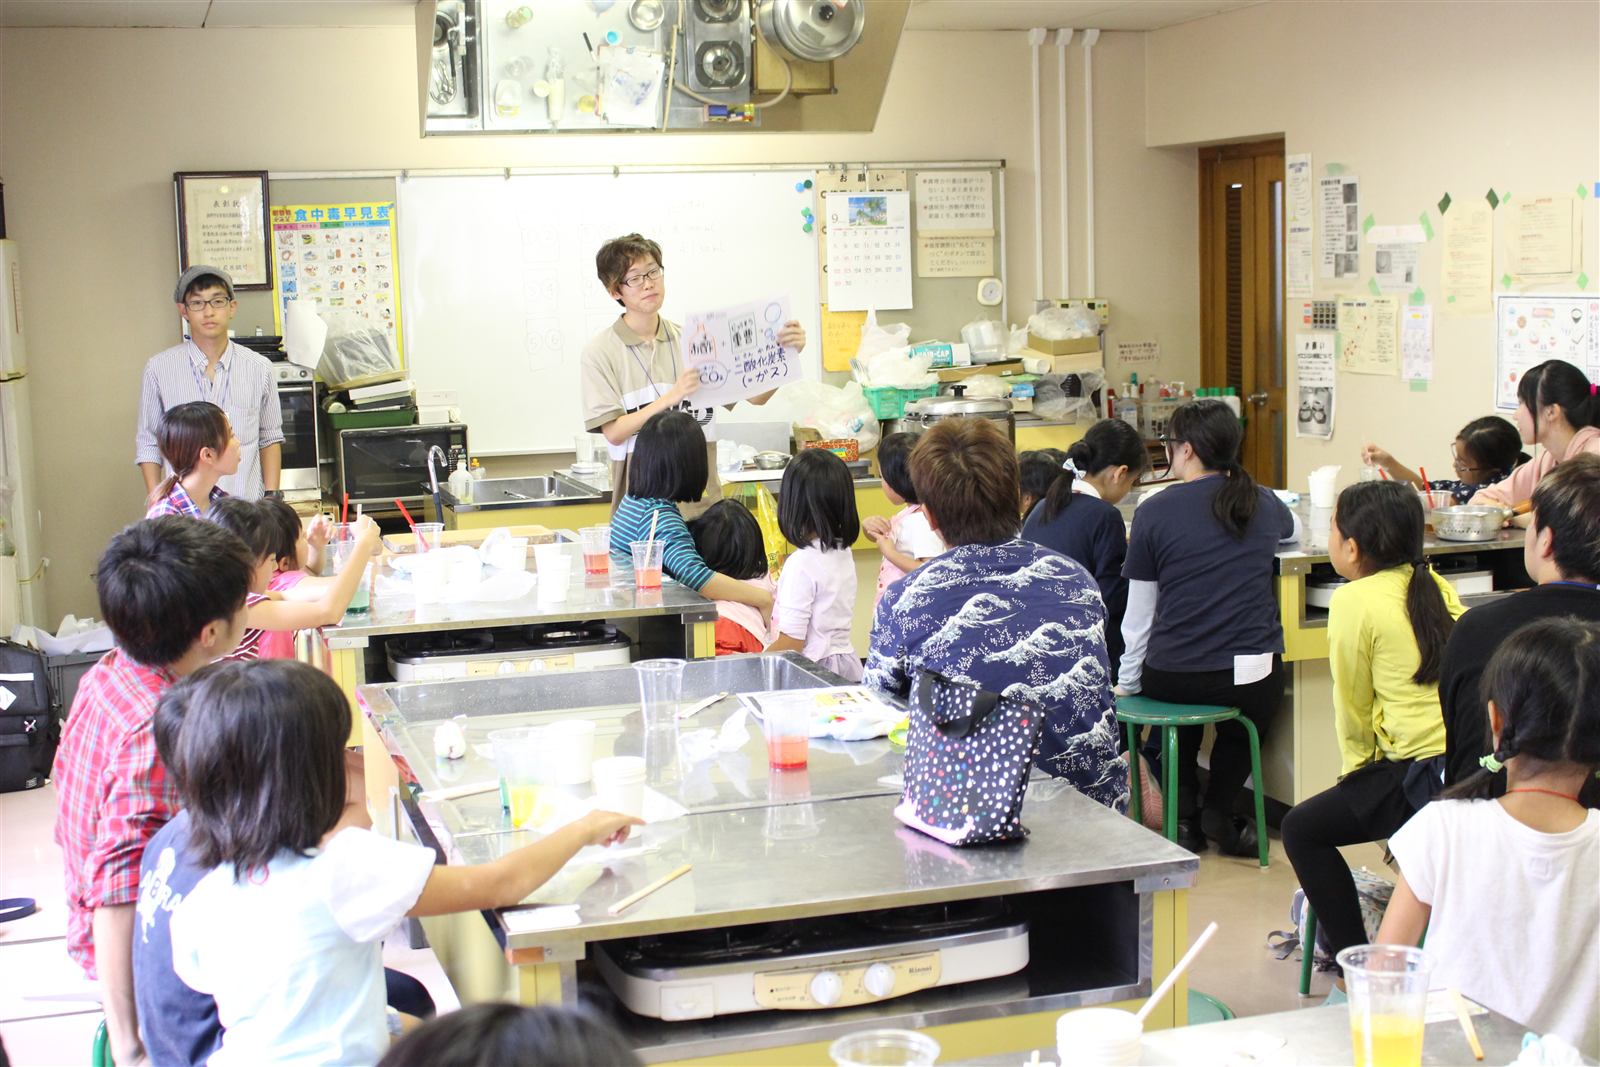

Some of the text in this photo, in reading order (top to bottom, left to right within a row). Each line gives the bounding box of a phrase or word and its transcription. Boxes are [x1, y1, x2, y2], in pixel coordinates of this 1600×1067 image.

[294, 206, 389, 222] 食中毒早見表
[831, 213, 839, 223] 9
[734, 346, 787, 376] 二酸化炭素
